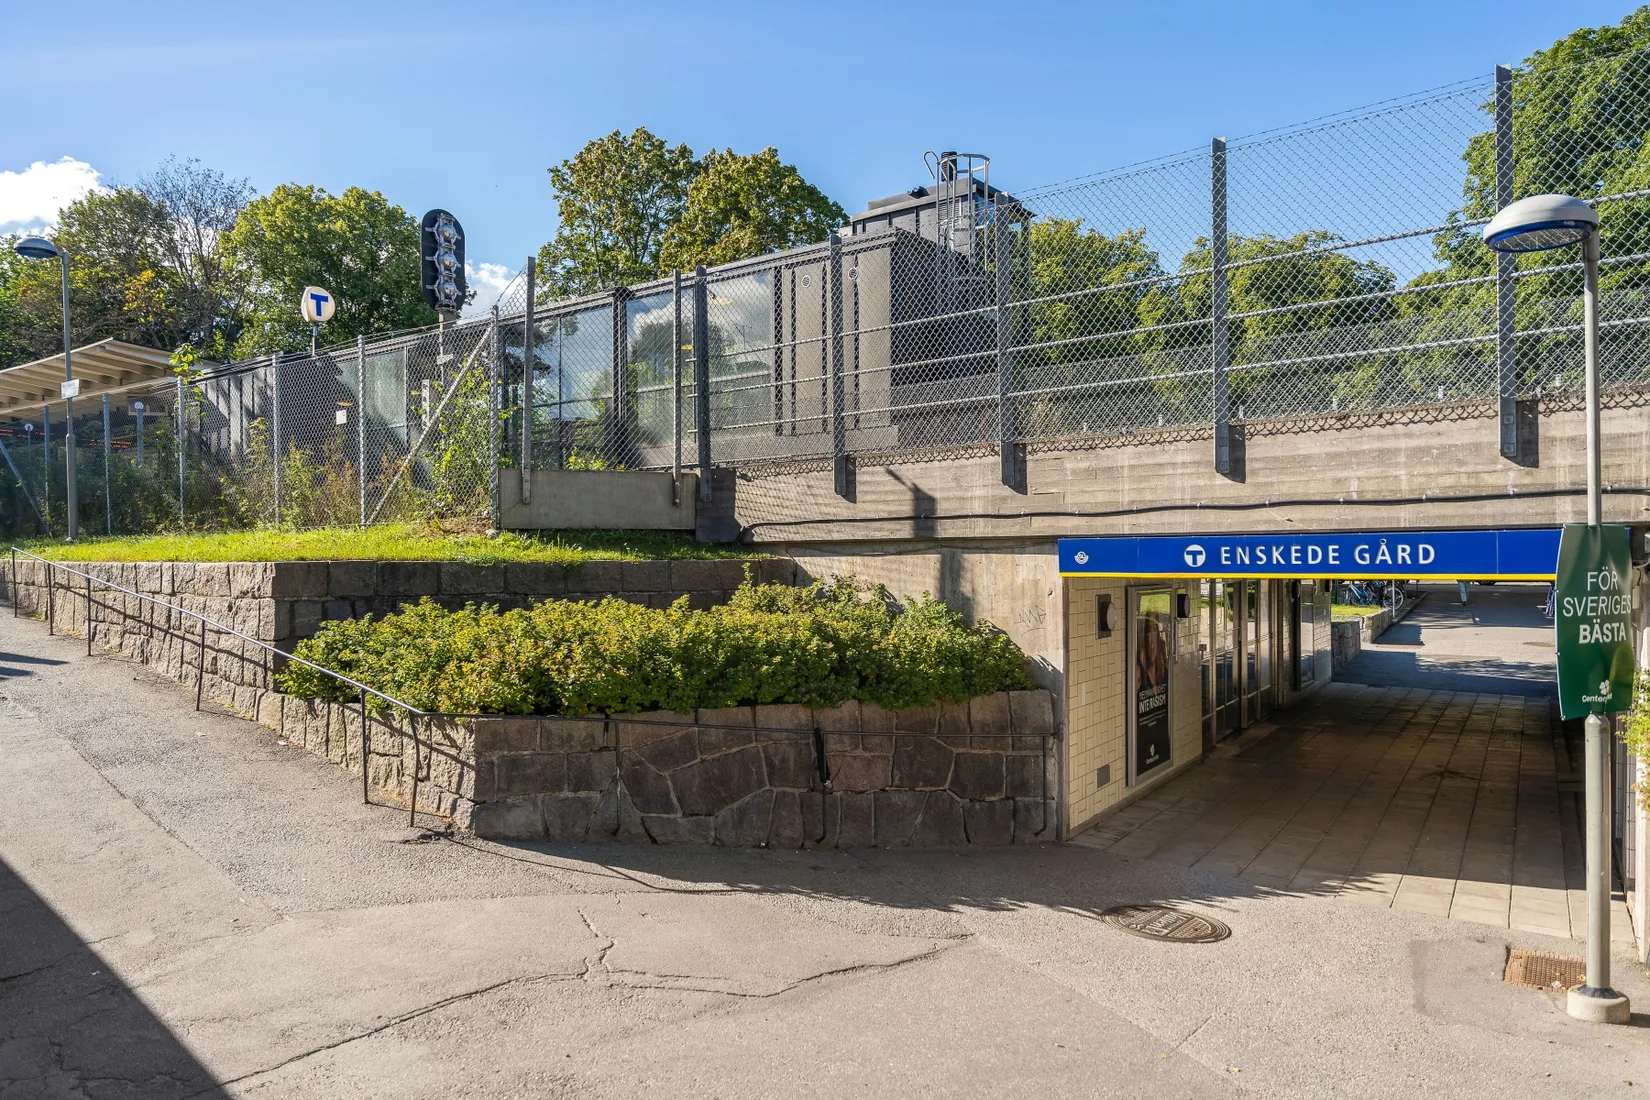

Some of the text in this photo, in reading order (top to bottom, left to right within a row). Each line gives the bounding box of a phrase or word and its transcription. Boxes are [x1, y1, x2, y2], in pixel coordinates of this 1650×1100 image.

[310, 292, 329, 317] T
[1221, 546, 1340, 565] ENSKEDE
[1354, 538, 1436, 565] GÅRD
[1587, 566, 1618, 591] FÖR
[1562, 595, 1632, 617] SVERIGES
[1578, 618, 1627, 644] BÄSTA
